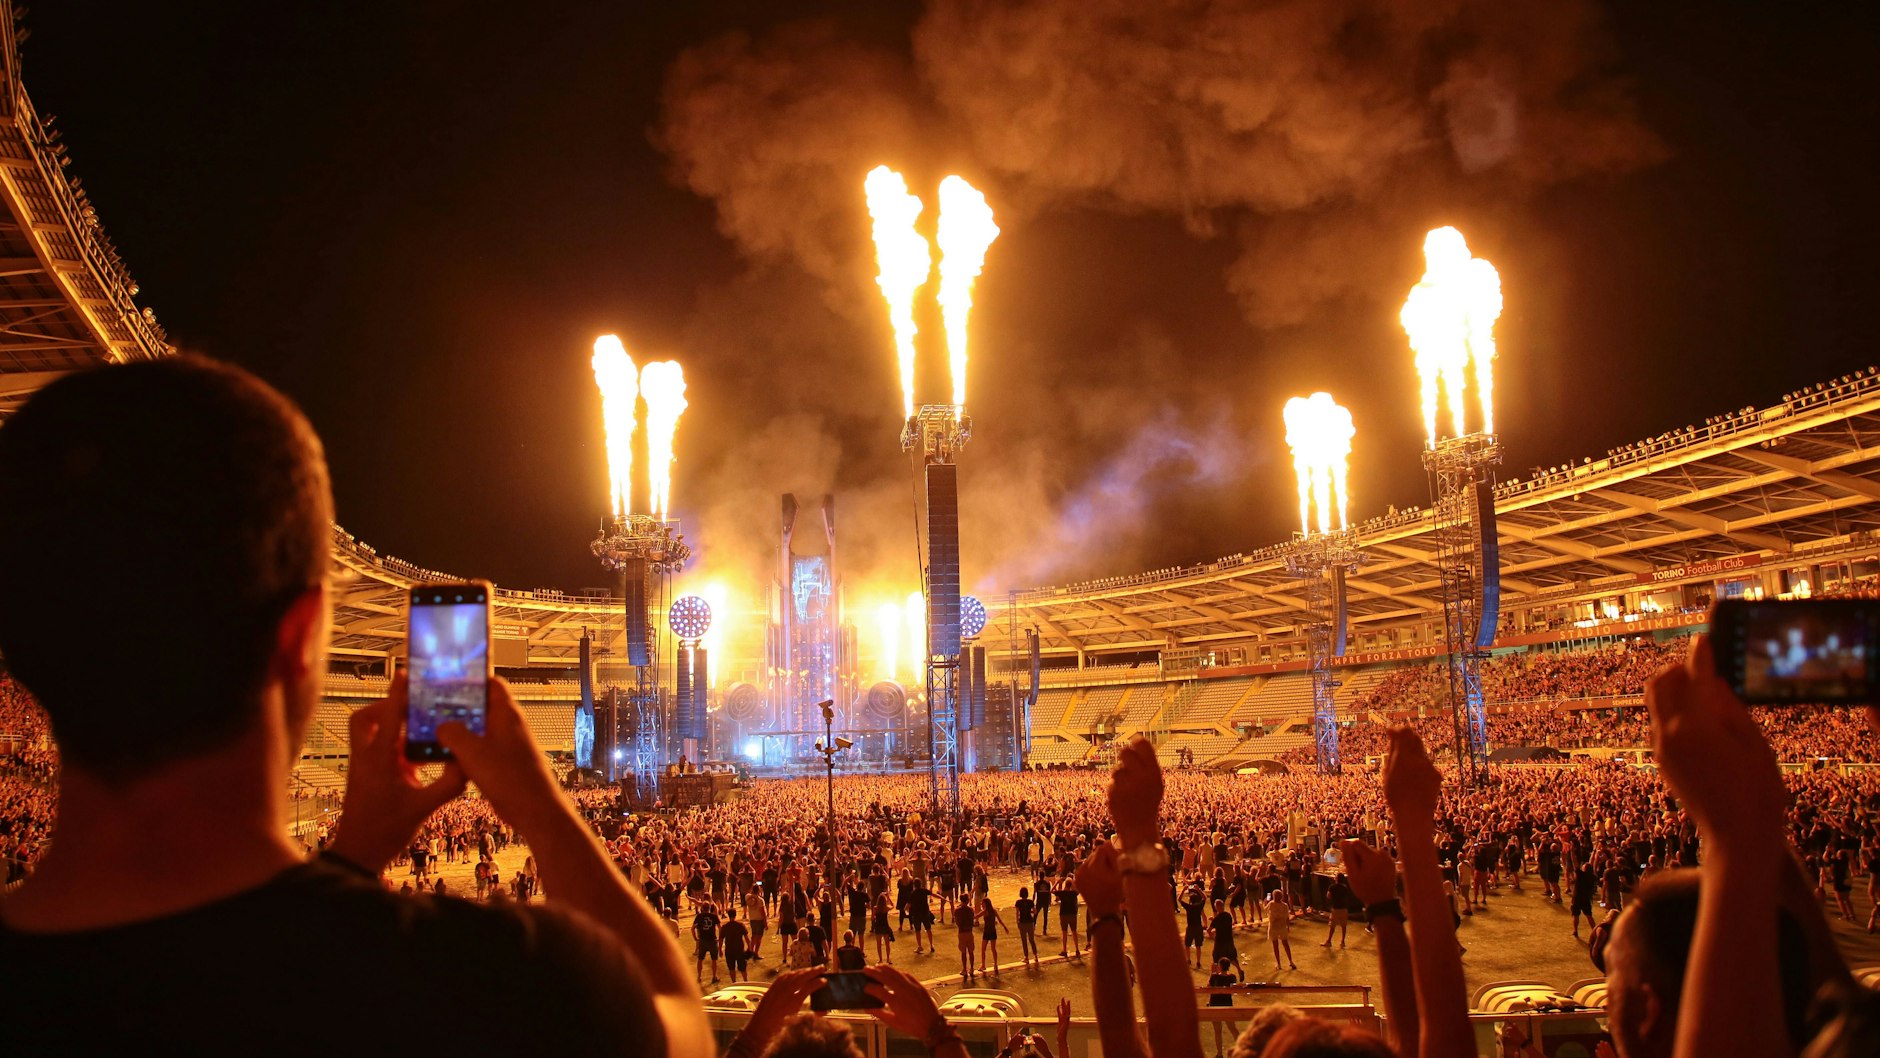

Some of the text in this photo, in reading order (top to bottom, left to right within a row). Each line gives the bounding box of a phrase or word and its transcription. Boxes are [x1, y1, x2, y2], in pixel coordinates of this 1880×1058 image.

[1652, 558, 1744, 581] TORINO Football Club
[1560, 613, 1706, 640] STADIO OLIMPICO
[1367, 650, 1402, 662] FORZA
[1407, 647, 1437, 658] TORO
[1335, 714, 1357, 722] UZUKI
